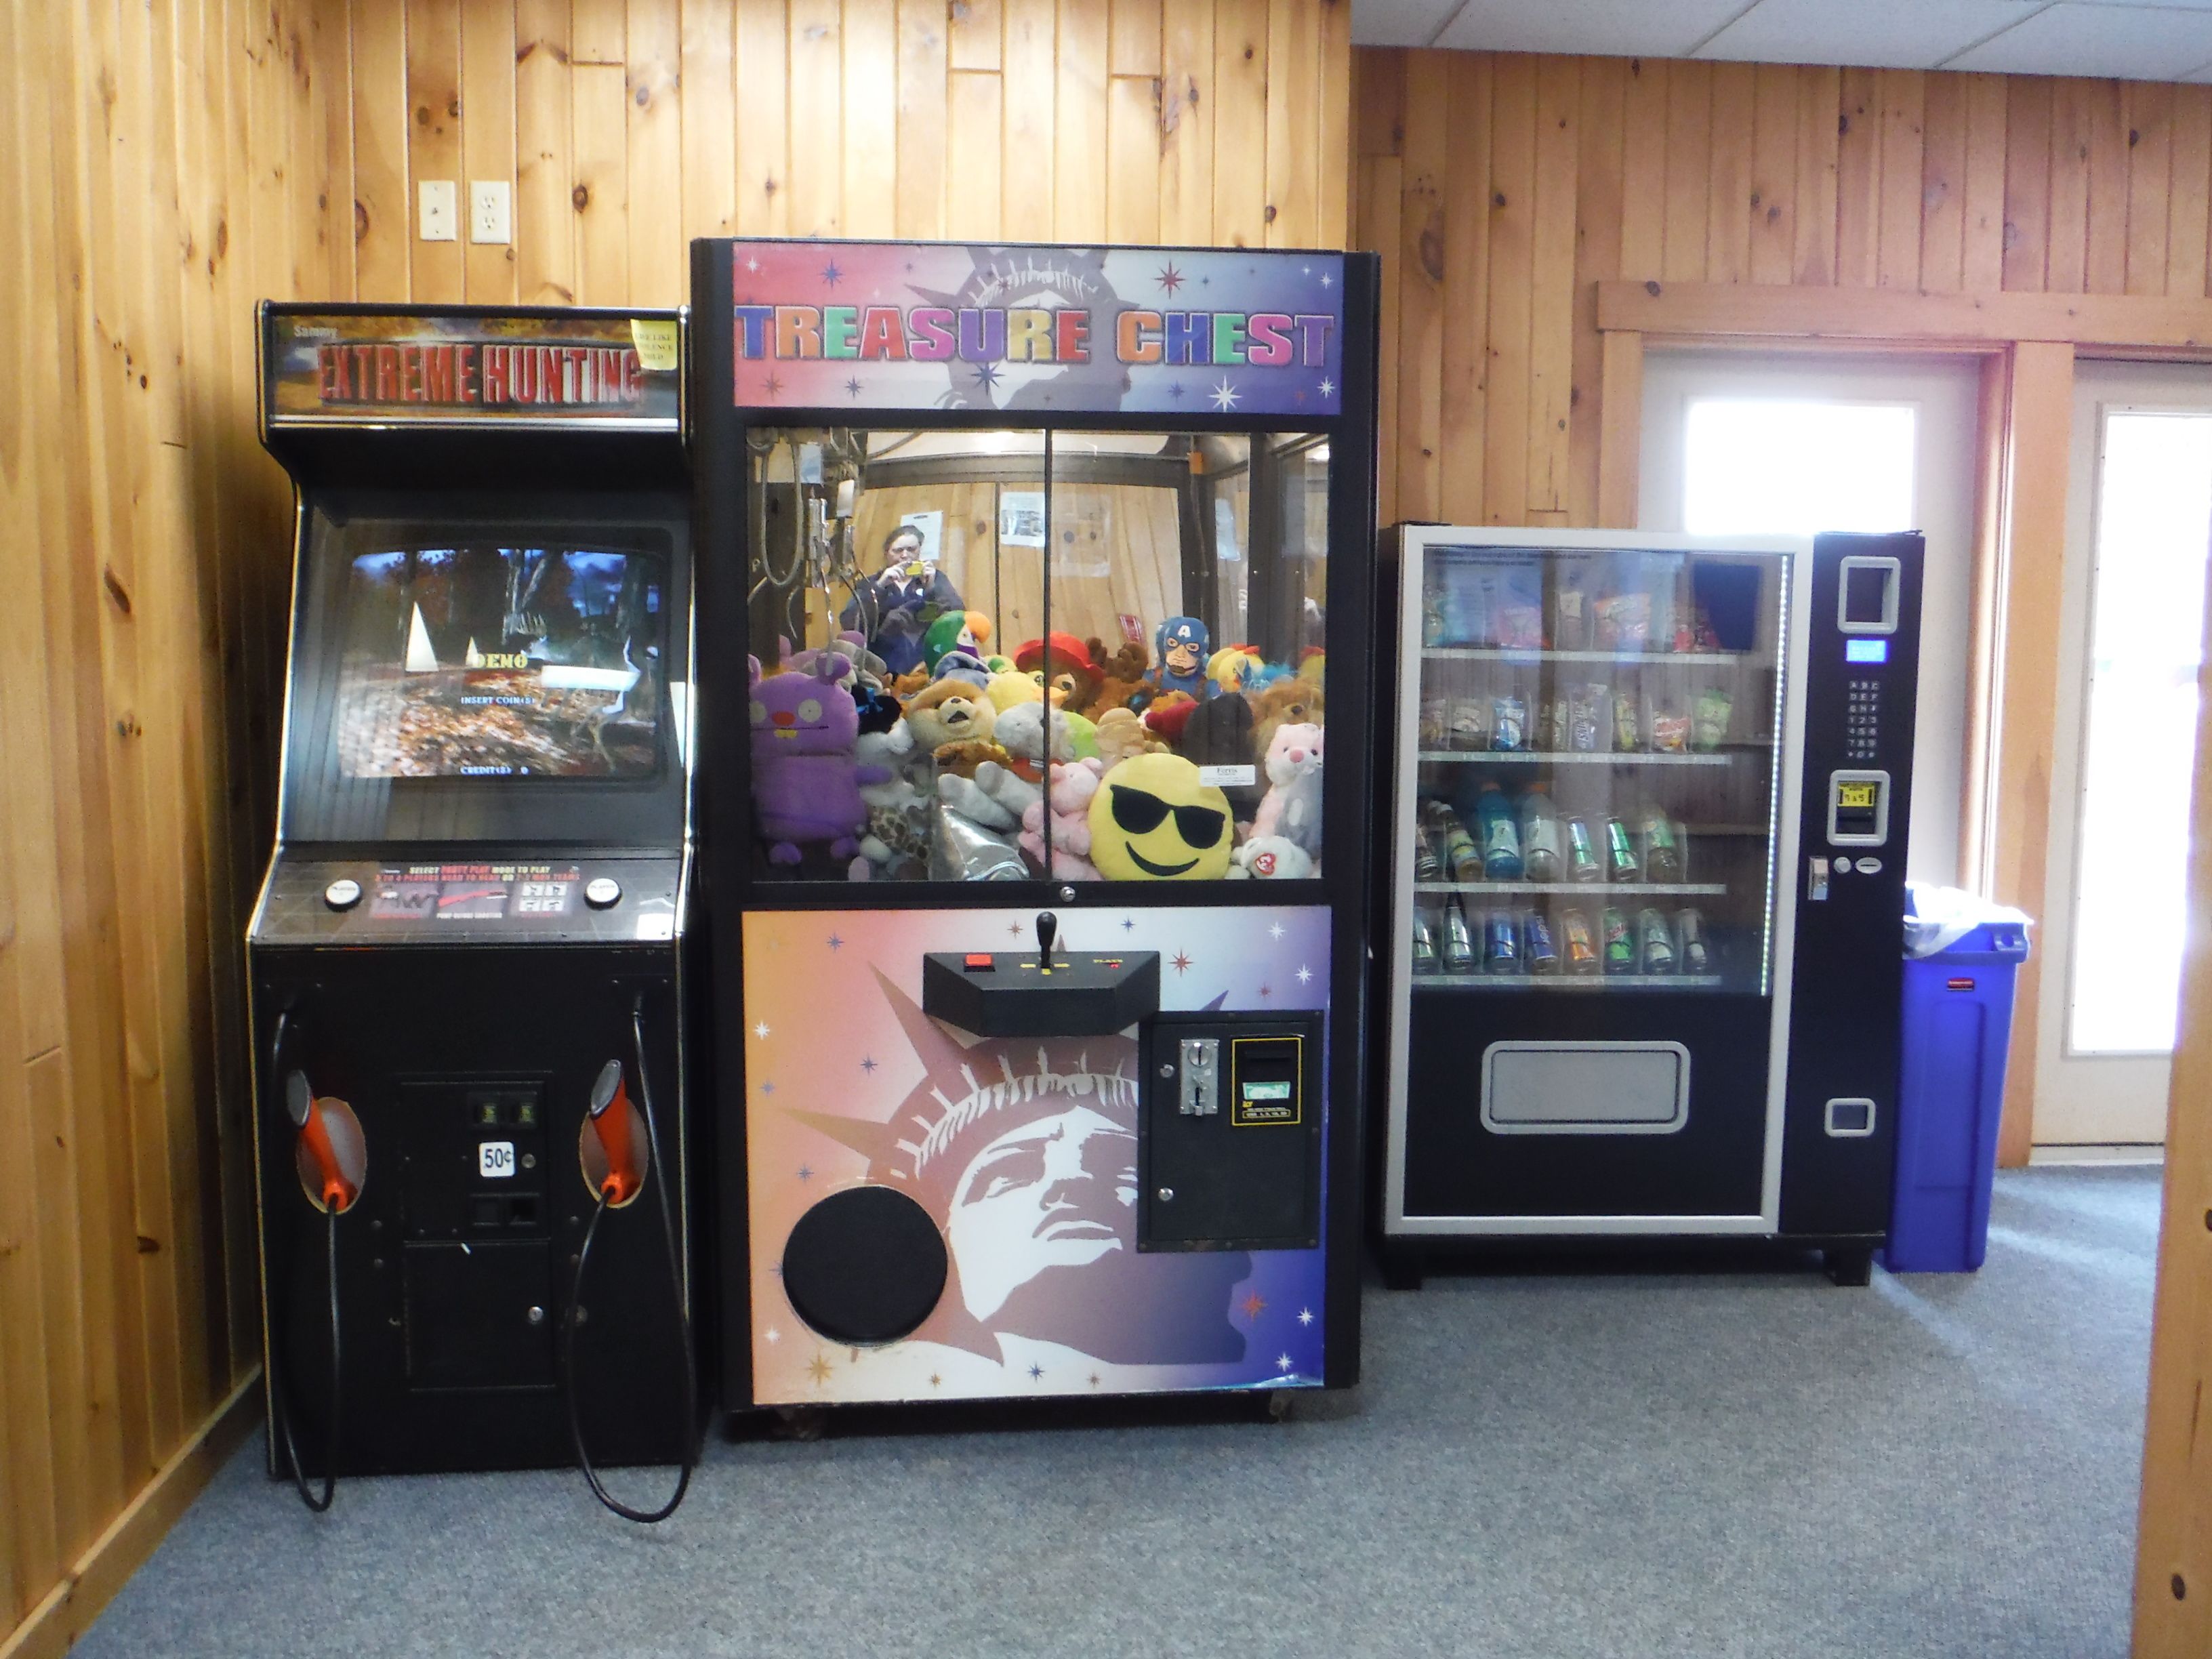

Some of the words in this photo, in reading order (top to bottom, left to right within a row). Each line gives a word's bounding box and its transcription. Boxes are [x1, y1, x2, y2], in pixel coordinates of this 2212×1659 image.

[735, 304, 1090, 363] TREASURE
[1117, 310, 1335, 368] CHEST
[317, 344, 475, 402] EXTREME
[483, 345, 644, 405] HUNTING
[1178, 625, 1191, 638] A
[473, 653, 528, 668] DEMO
[461, 696, 493, 704] INSERT
[495, 696, 535, 705] COIN(S)
[460, 766, 512, 775] CREDIT(S)
[409, 866, 440, 875] SELECT
[530, 866, 551, 874] PLAY
[484, 1148, 513, 1168] 50¢
